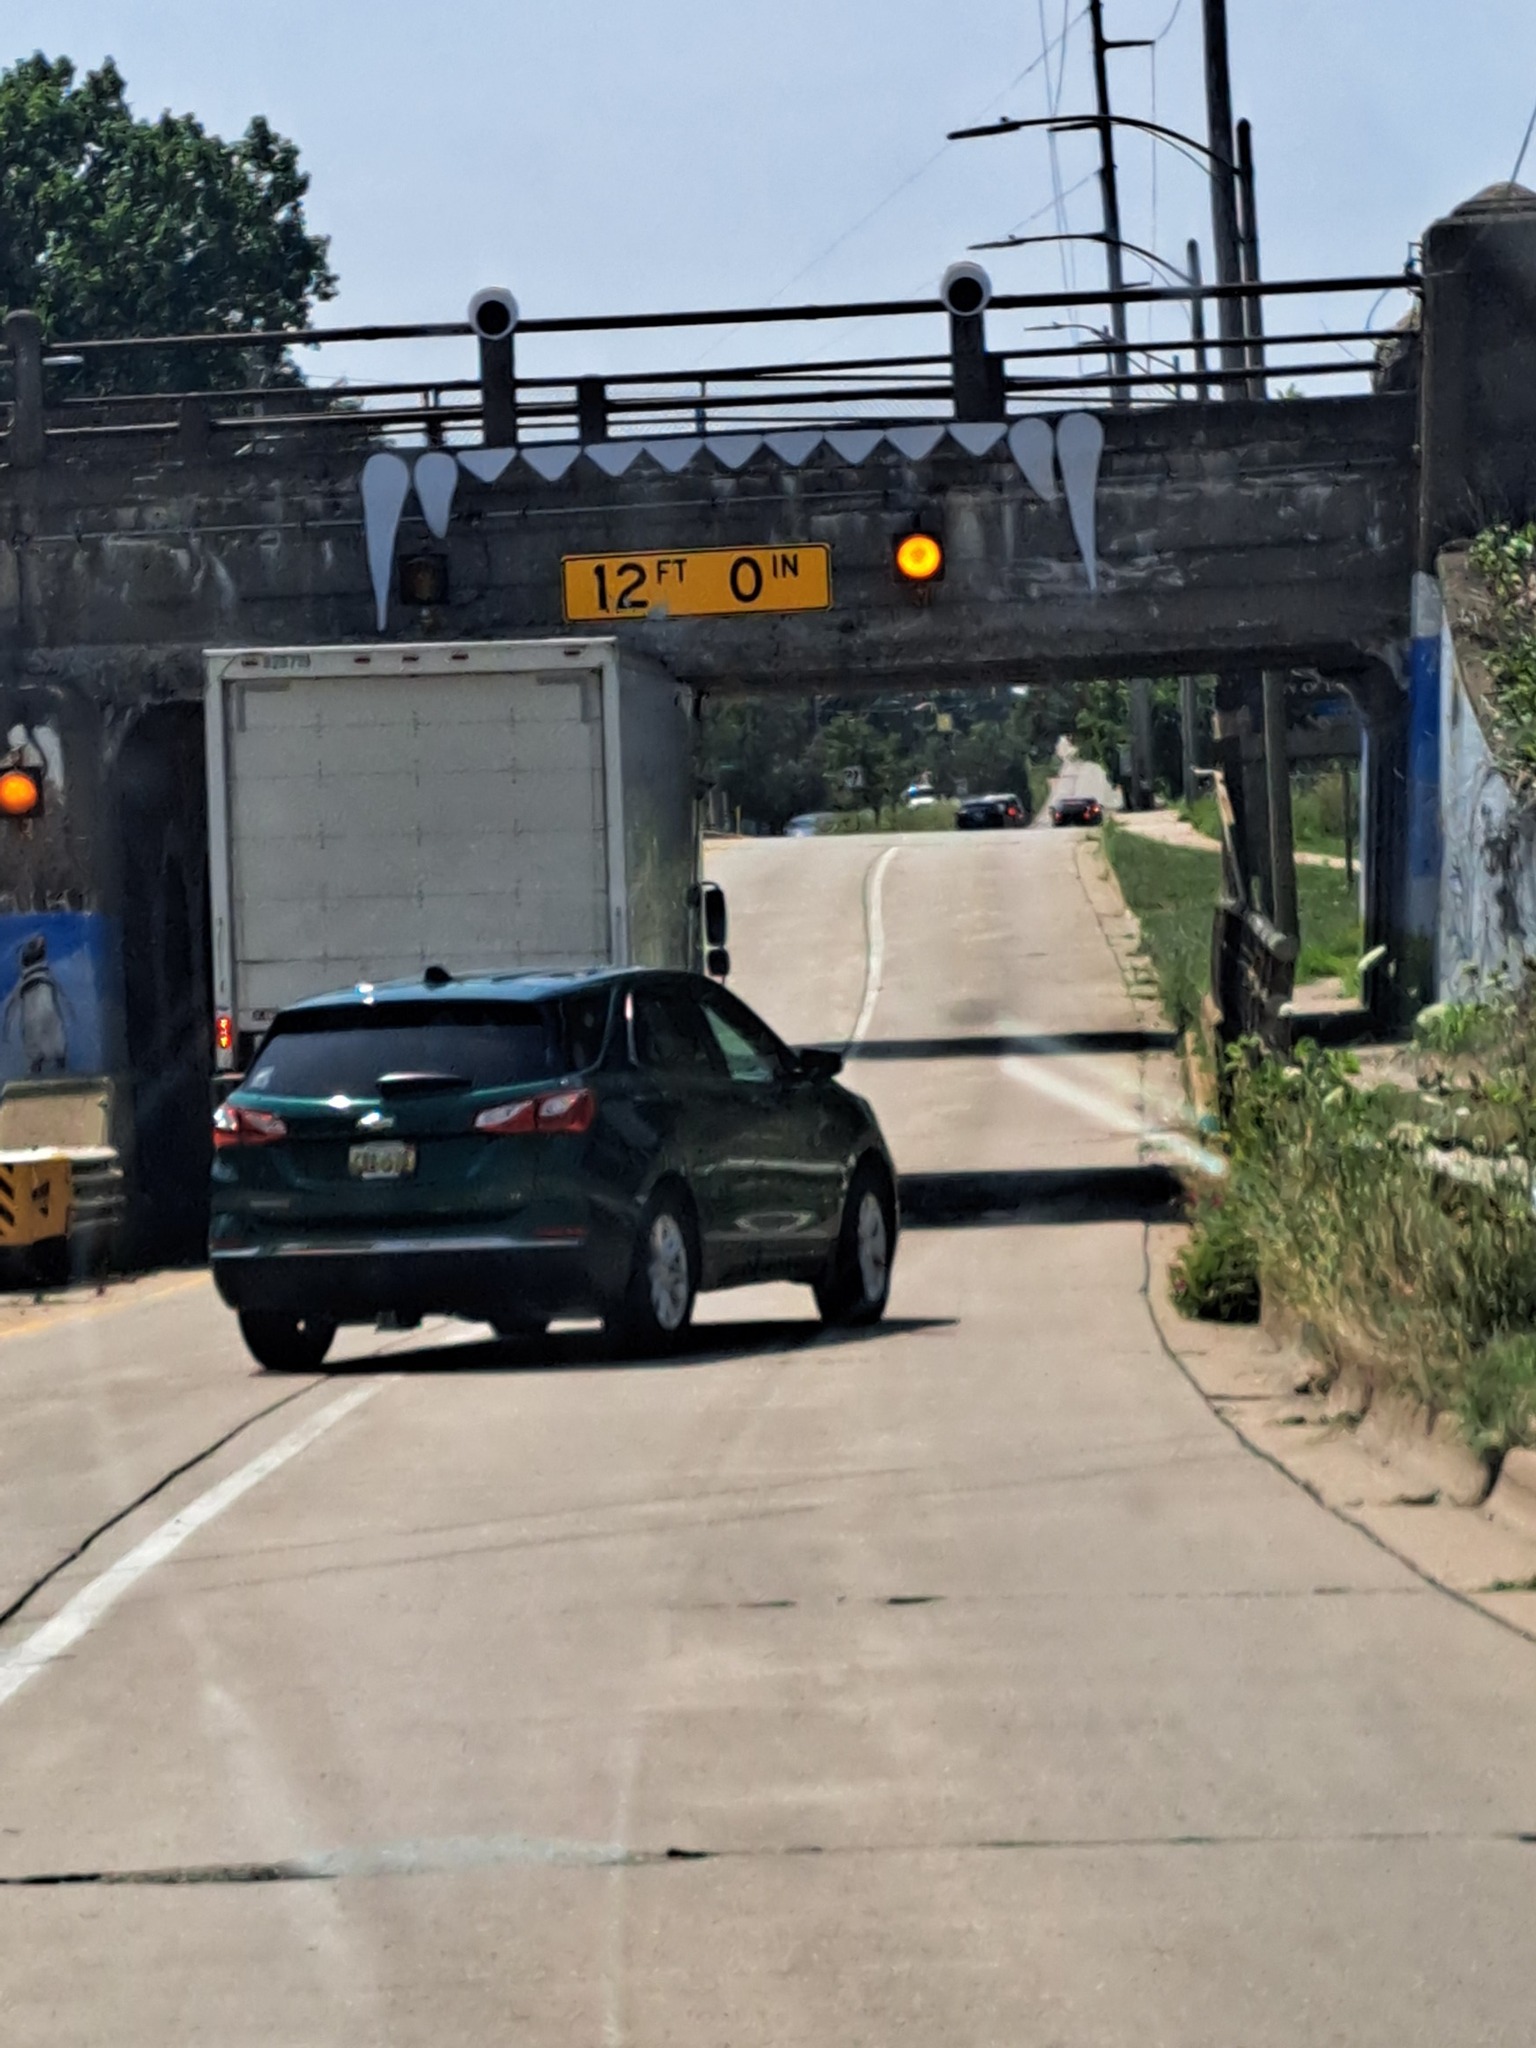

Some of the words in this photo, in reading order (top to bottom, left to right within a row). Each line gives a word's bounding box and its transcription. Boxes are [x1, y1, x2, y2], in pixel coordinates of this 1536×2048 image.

[594, 563, 648, 613] 12
[657, 559, 687, 585] FT
[730, 557, 763, 603] 0
[772, 554, 799, 578] IN
